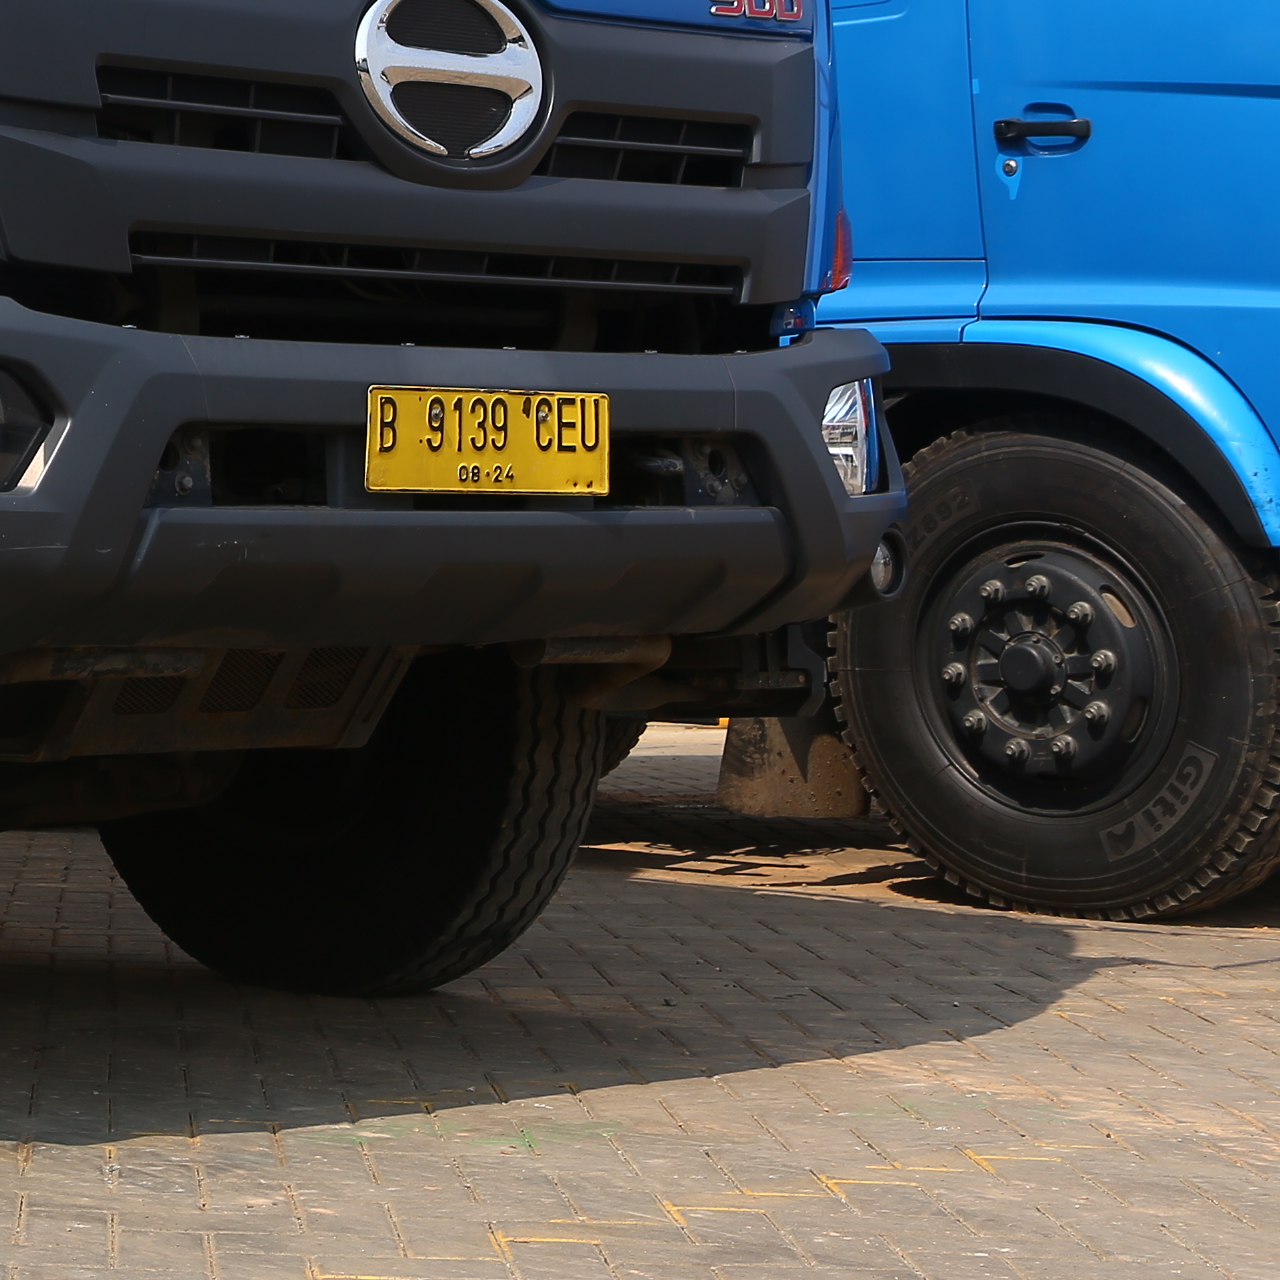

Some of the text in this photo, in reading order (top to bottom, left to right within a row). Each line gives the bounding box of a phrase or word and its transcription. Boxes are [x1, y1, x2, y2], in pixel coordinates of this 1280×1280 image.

[379, 394, 600, 453] B 9139 CEU
